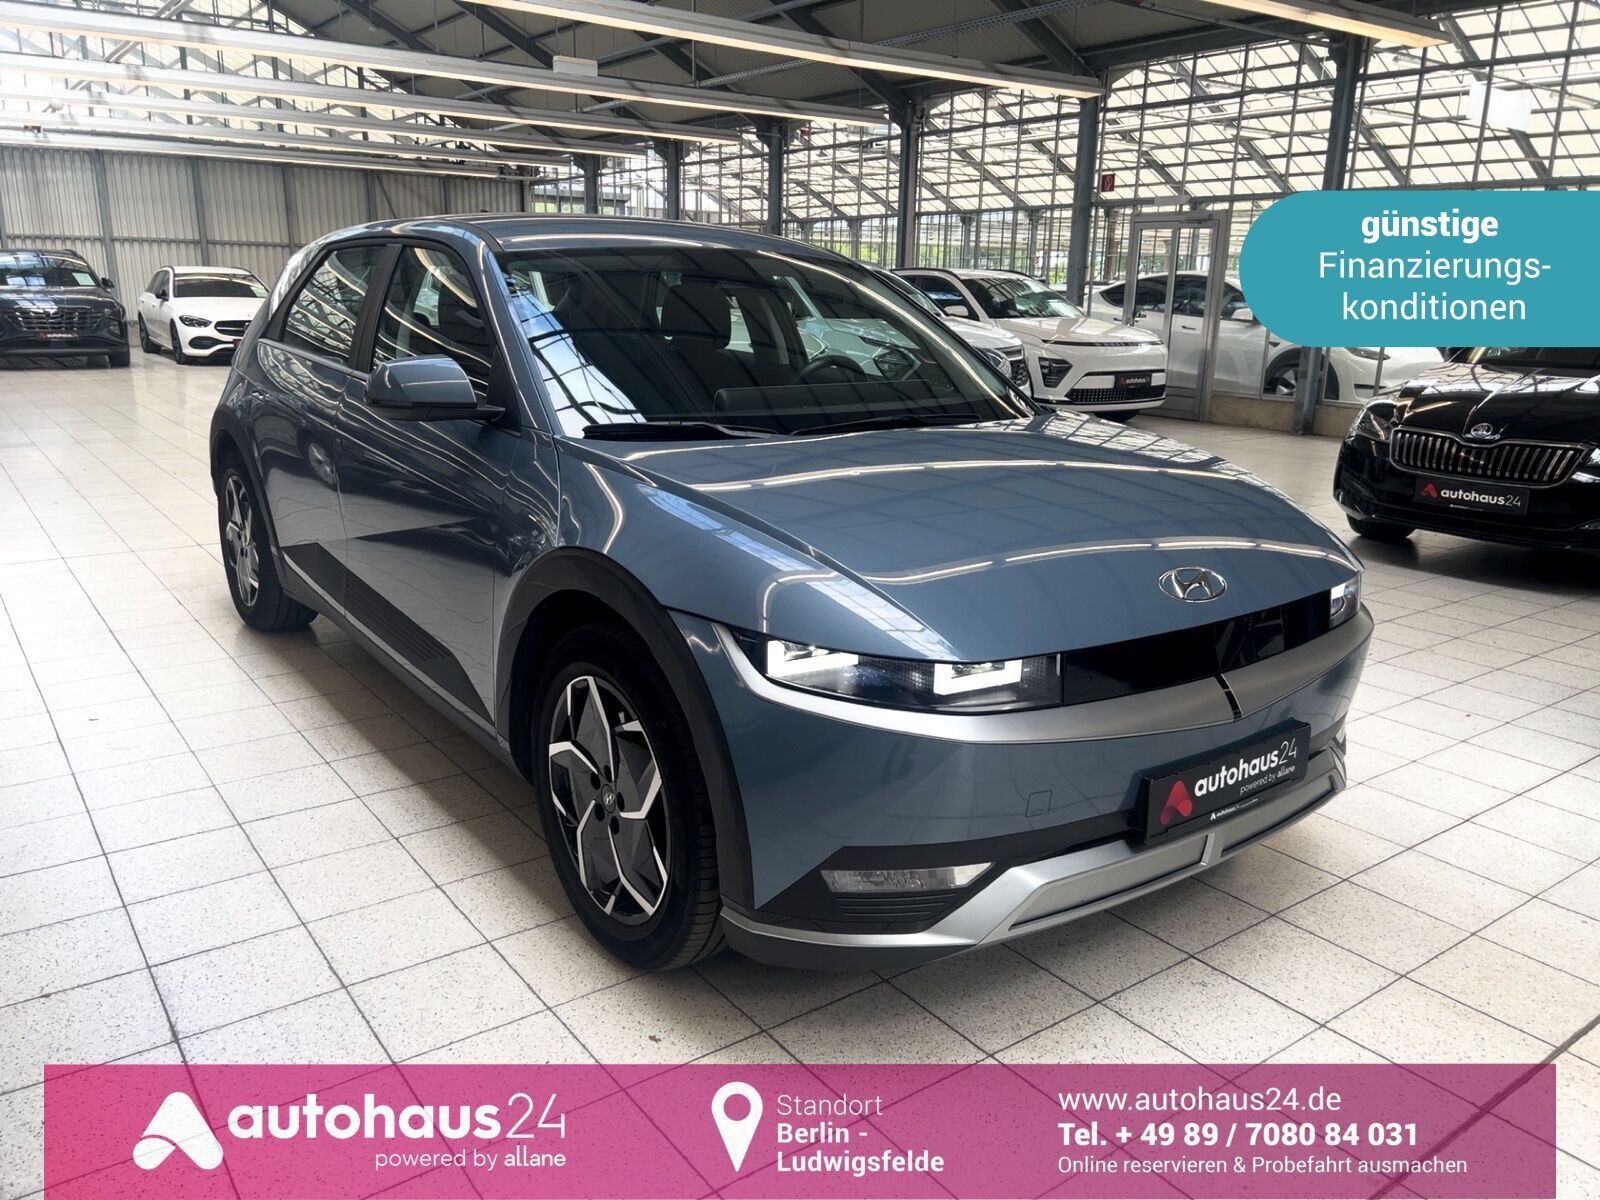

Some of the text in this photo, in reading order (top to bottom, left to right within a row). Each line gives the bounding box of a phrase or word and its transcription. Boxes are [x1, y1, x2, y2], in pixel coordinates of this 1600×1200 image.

[1440, 489, 1521, 507] autohaus24
[1194, 738, 1298, 797] autohaus24
[1240, 765, 1296, 795] powered by allane
